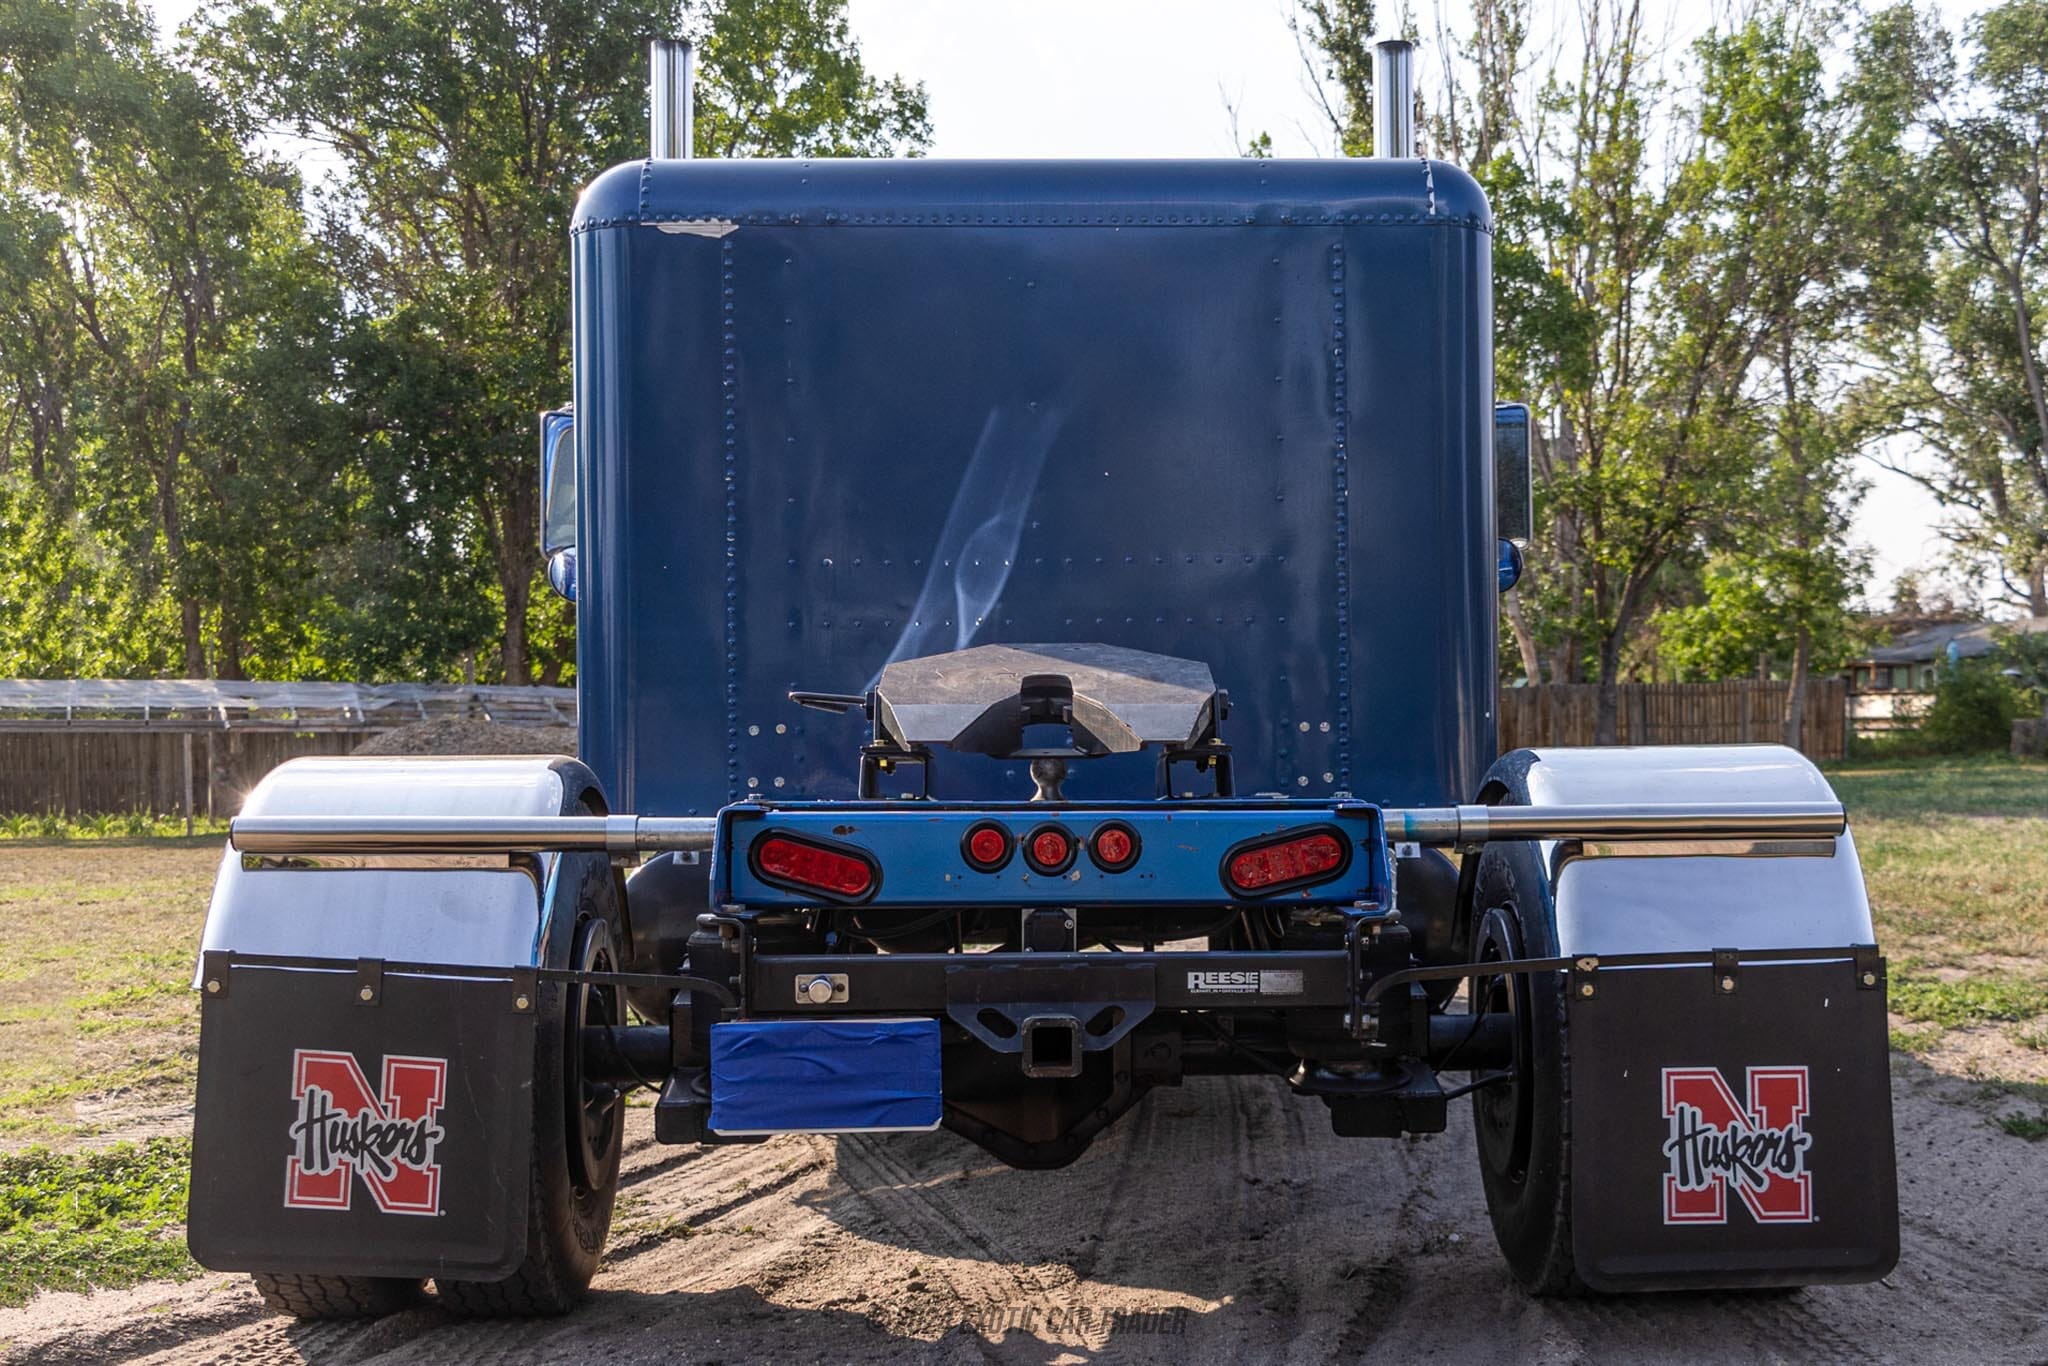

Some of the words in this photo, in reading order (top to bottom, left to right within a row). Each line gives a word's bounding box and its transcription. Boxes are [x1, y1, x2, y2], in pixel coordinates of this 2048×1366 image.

[1187, 971, 1259, 989] REESE
[292, 1087, 442, 1180] Huskers
[1667, 1104, 1810, 1189] Huskers
